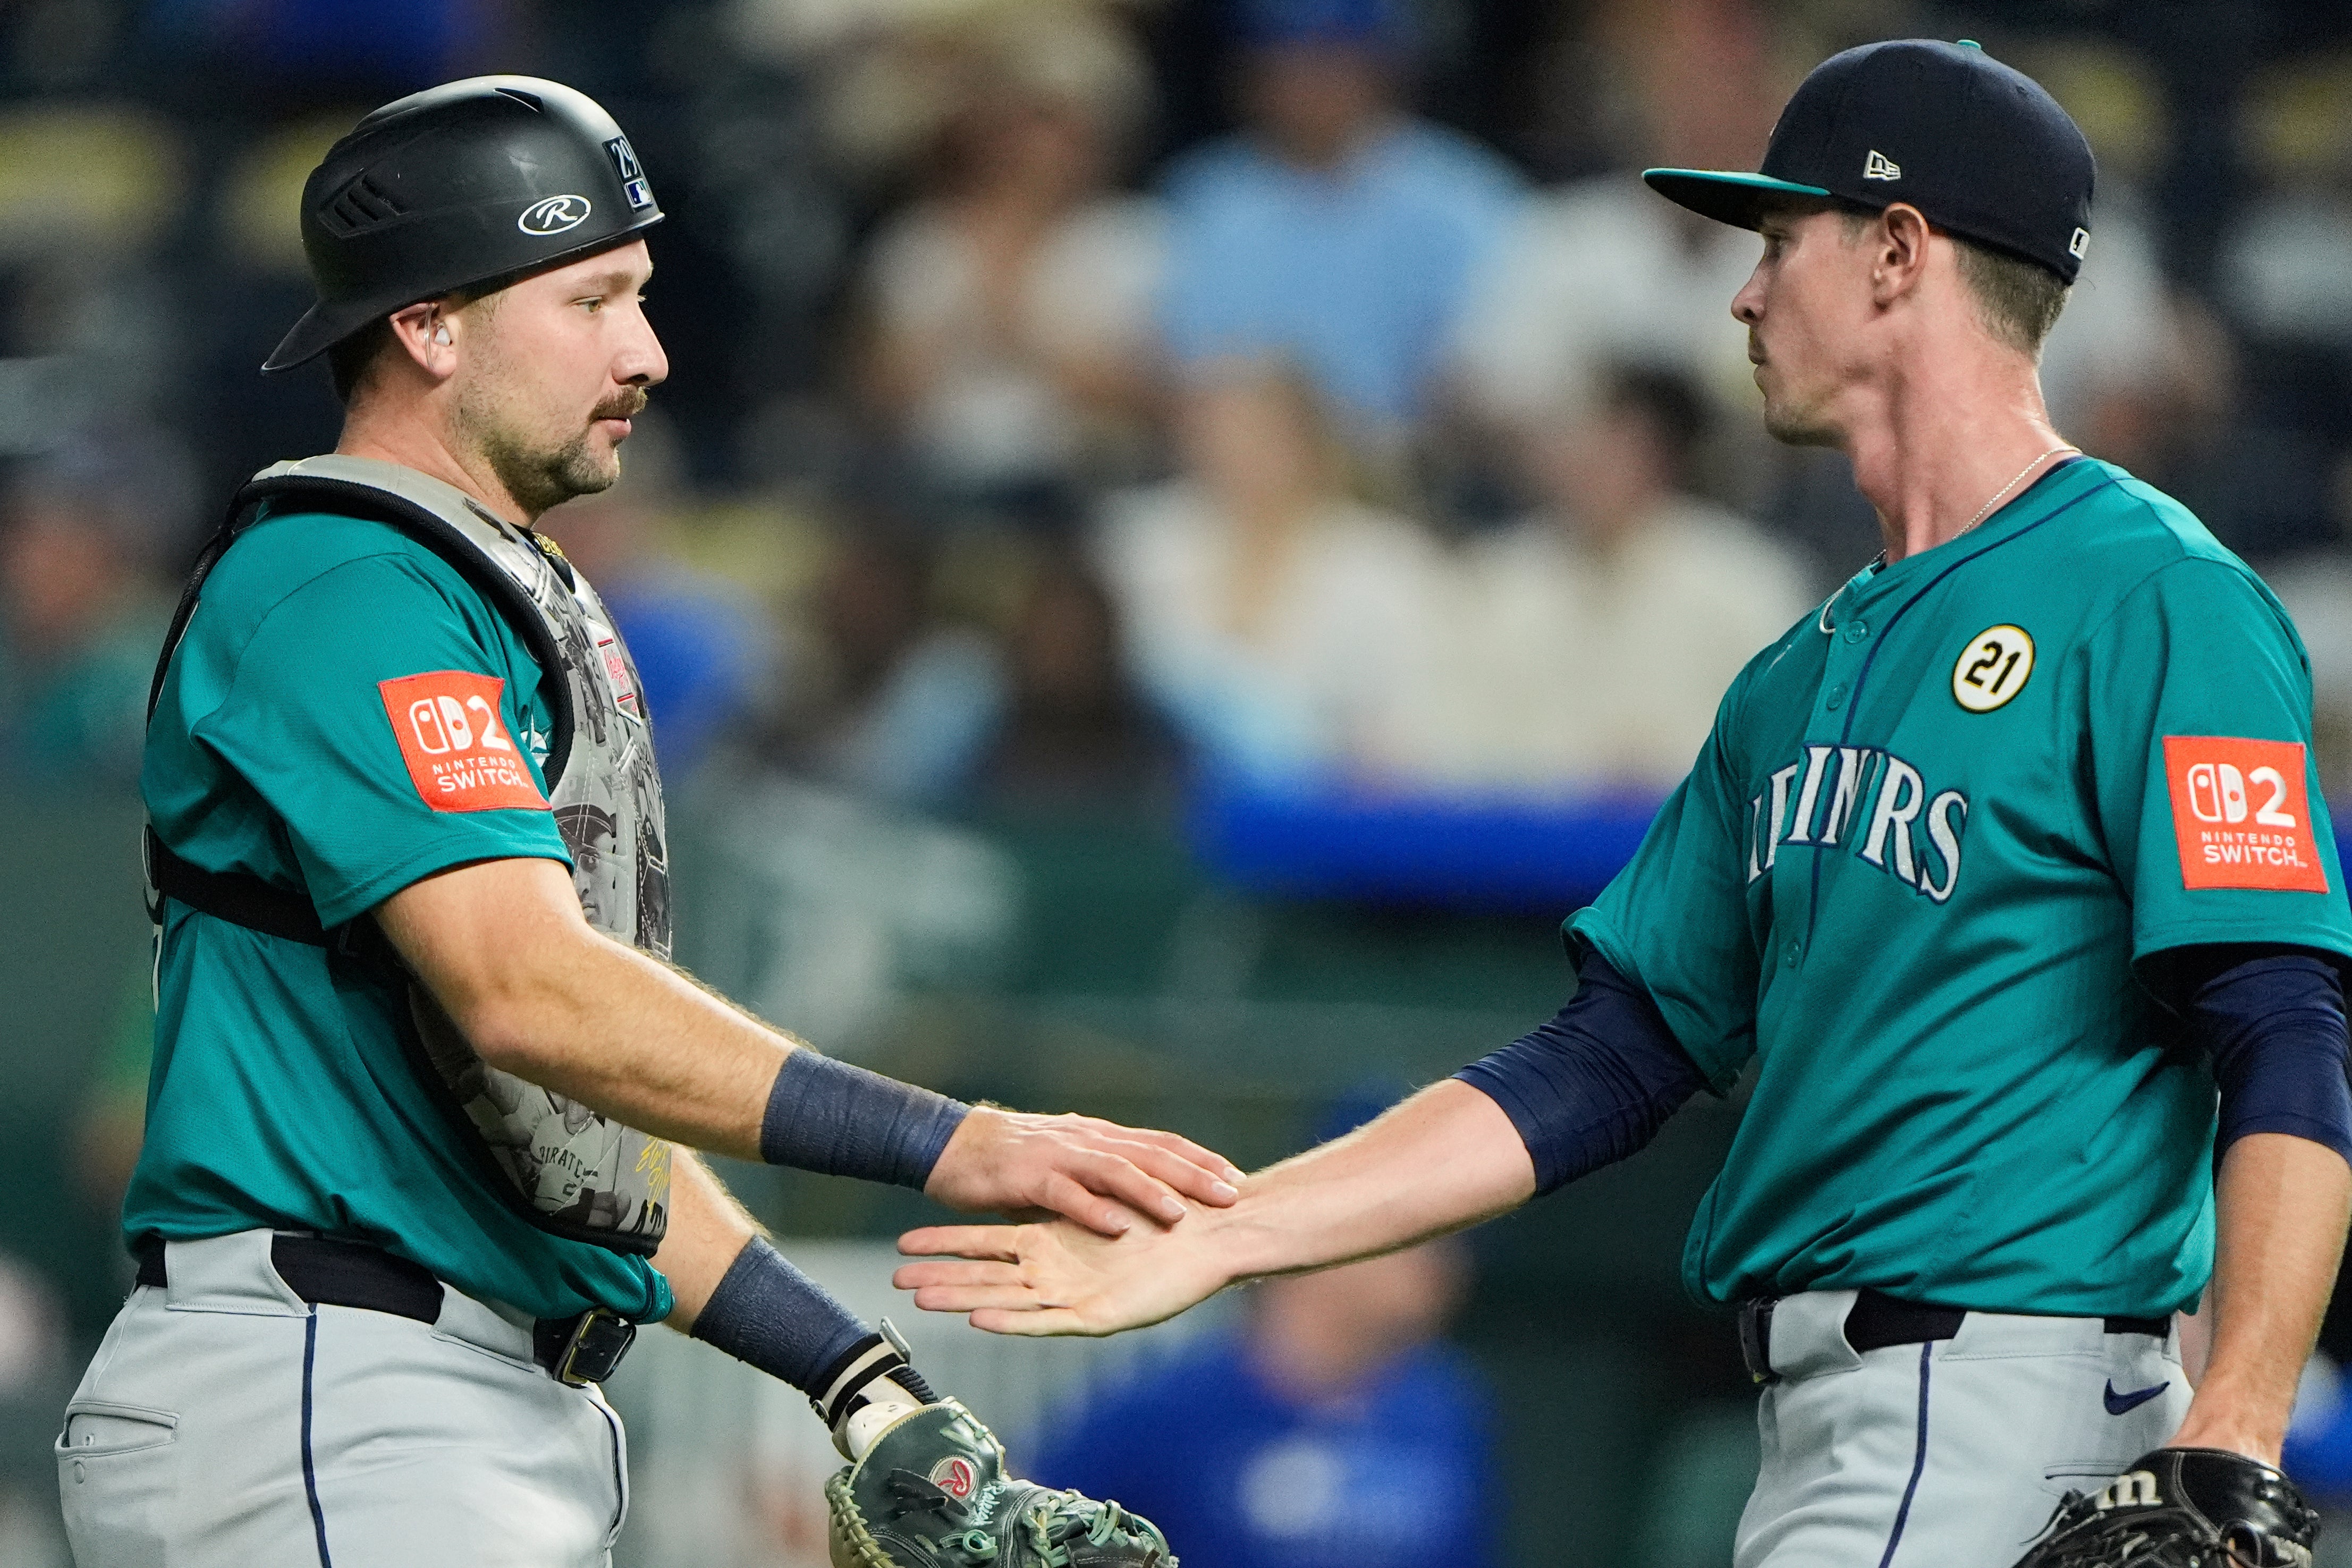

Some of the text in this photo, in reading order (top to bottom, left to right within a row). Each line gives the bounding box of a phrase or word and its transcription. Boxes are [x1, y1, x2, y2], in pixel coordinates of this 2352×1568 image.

[611, 139, 638, 179] 29
[536, 198, 578, 228] R
[1962, 640, 2021, 696] 21
[466, 694, 511, 751] 2
[432, 756, 516, 775] NINTENDO
[437, 768, 524, 792] SWITCH
[2249, 766, 2296, 828] 2
[2202, 831, 2296, 847] NINTENDO
[2204, 845, 2298, 867] SWITCH
[937, 1460, 970, 1496] R
